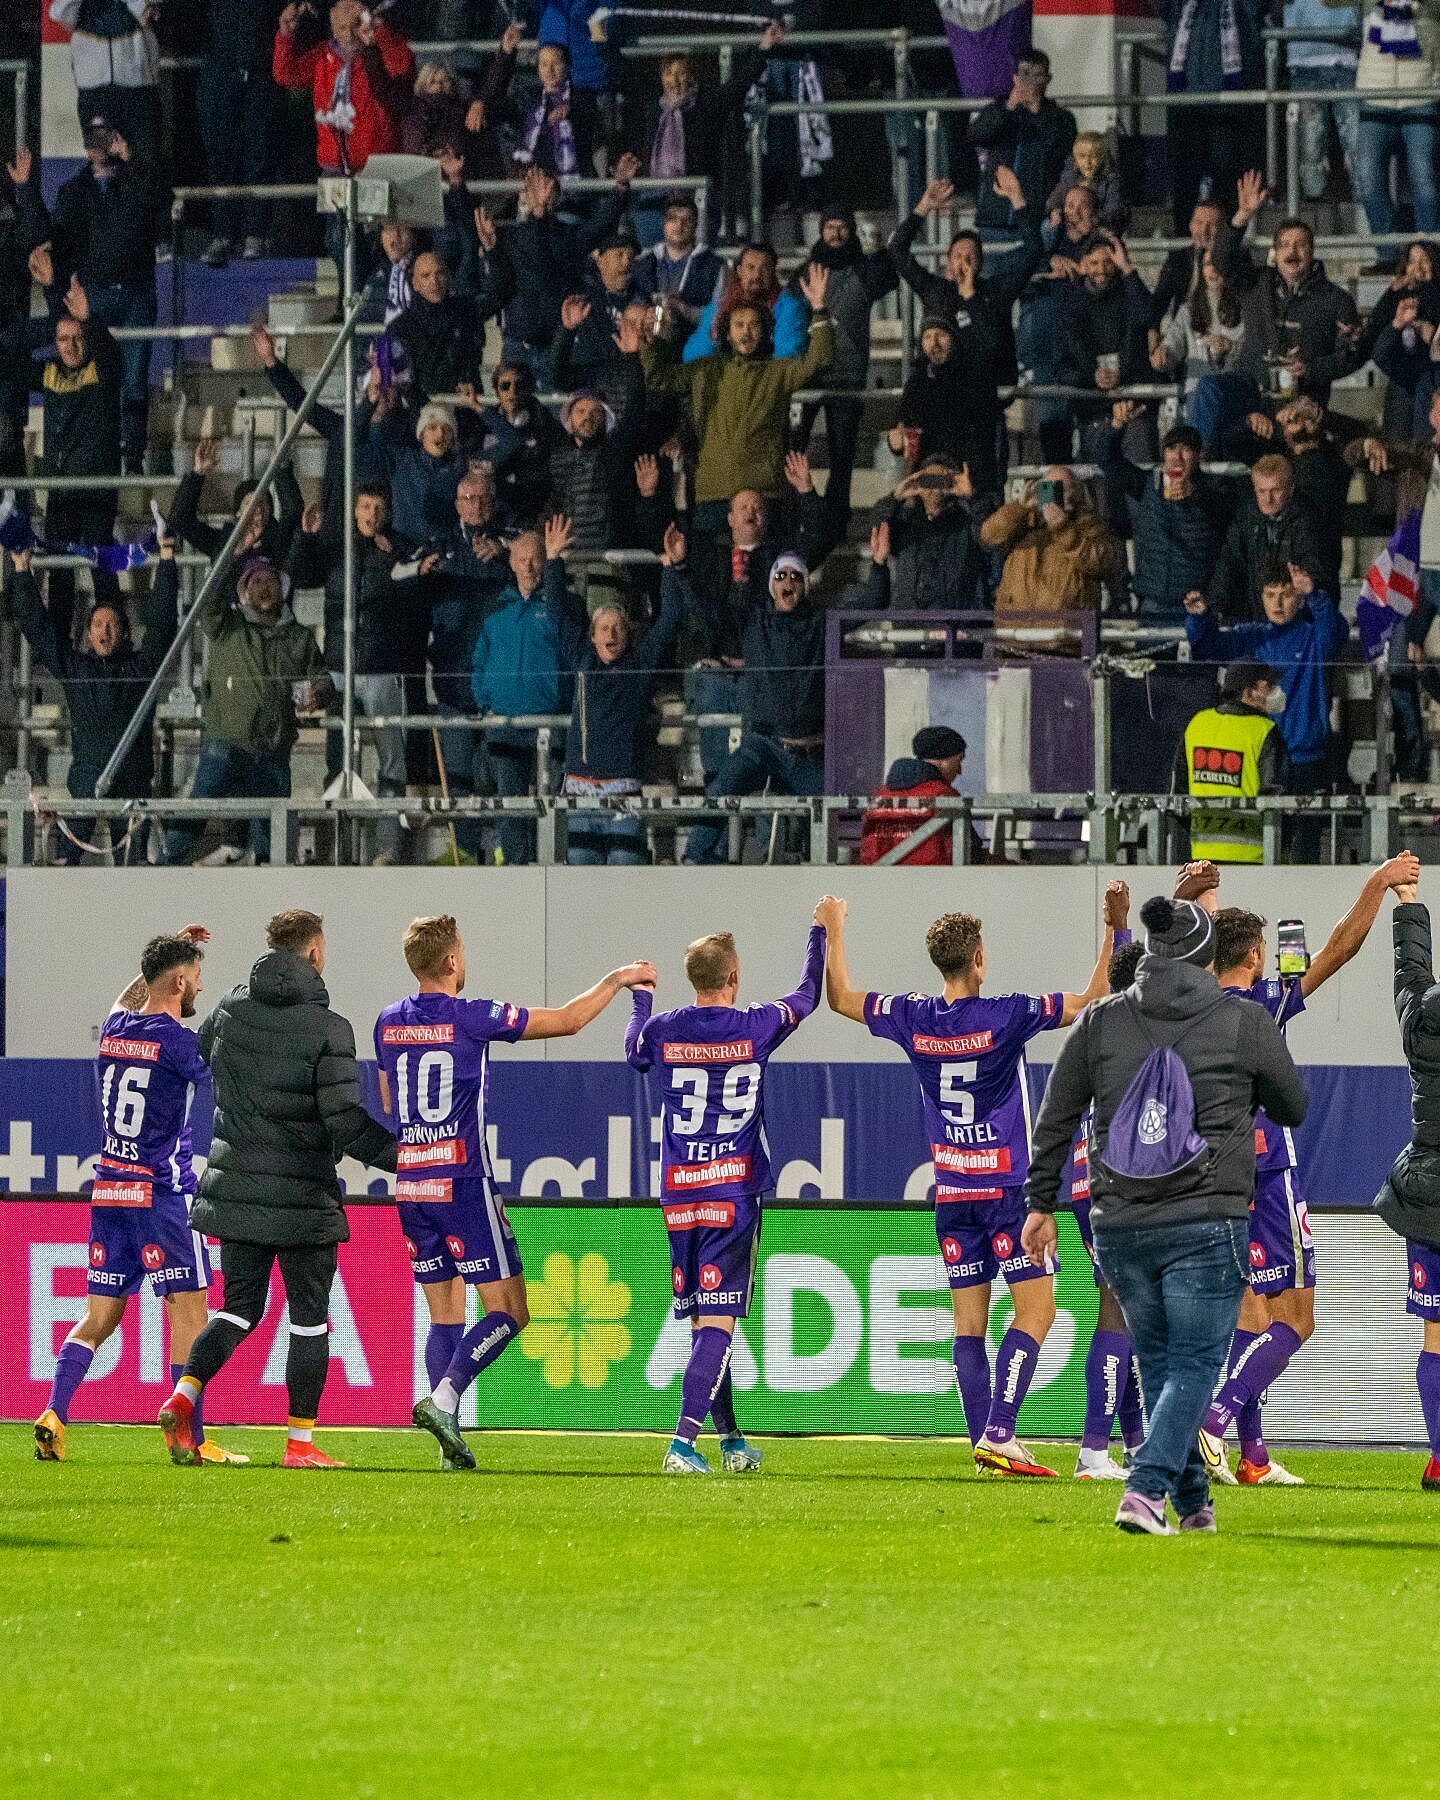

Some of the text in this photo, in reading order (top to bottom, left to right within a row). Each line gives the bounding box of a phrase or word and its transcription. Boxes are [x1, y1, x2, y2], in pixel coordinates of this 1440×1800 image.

[396, 1026, 451, 1041] GENERALI
[929, 1034, 990, 1052] GENERALI
[109, 1042, 157, 1059] GENERALI
[683, 1042, 750, 1060] GENERALI
[396, 1050, 454, 1124] 10
[940, 1060, 978, 1125] 5
[102, 1063, 152, 1139] 16
[671, 1062, 762, 1135] 39
[945, 1123, 998, 1144] ARTEL
[673, 1161, 746, 1185] wienholding
[92, 1183, 145, 1203] ienholding
[665, 1205, 728, 1226] wienholding
[947, 1261, 984, 1278] RSBET
[999, 1255, 1033, 1273] RSBE
[149, 1266, 191, 1284] RSBET
[697, 1291, 743, 1305] ARSBET
[645, 1253, 1077, 1395] ADEG
